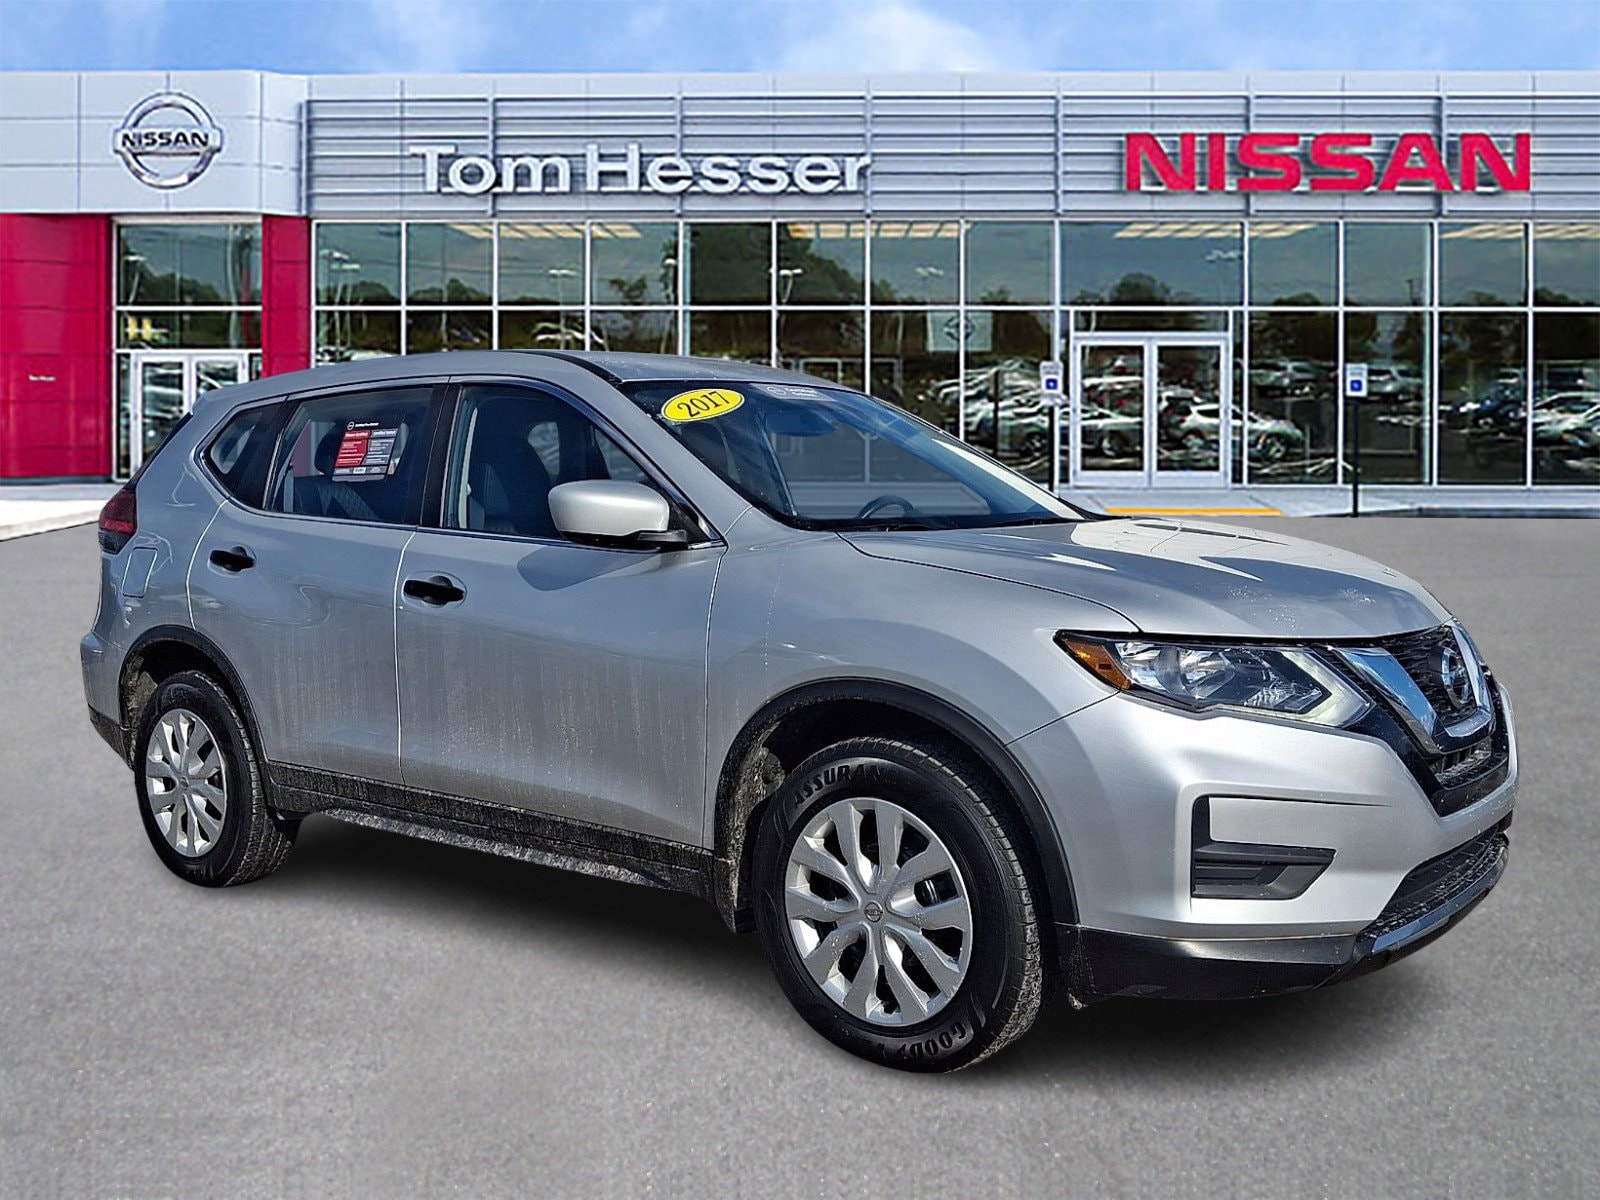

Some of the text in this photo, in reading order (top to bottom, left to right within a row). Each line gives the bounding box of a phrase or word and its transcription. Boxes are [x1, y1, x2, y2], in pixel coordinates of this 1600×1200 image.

[122, 131, 209, 147] NISSAN
[1126, 132, 1531, 191] NISSAN
[677, 391, 730, 417] 2017
